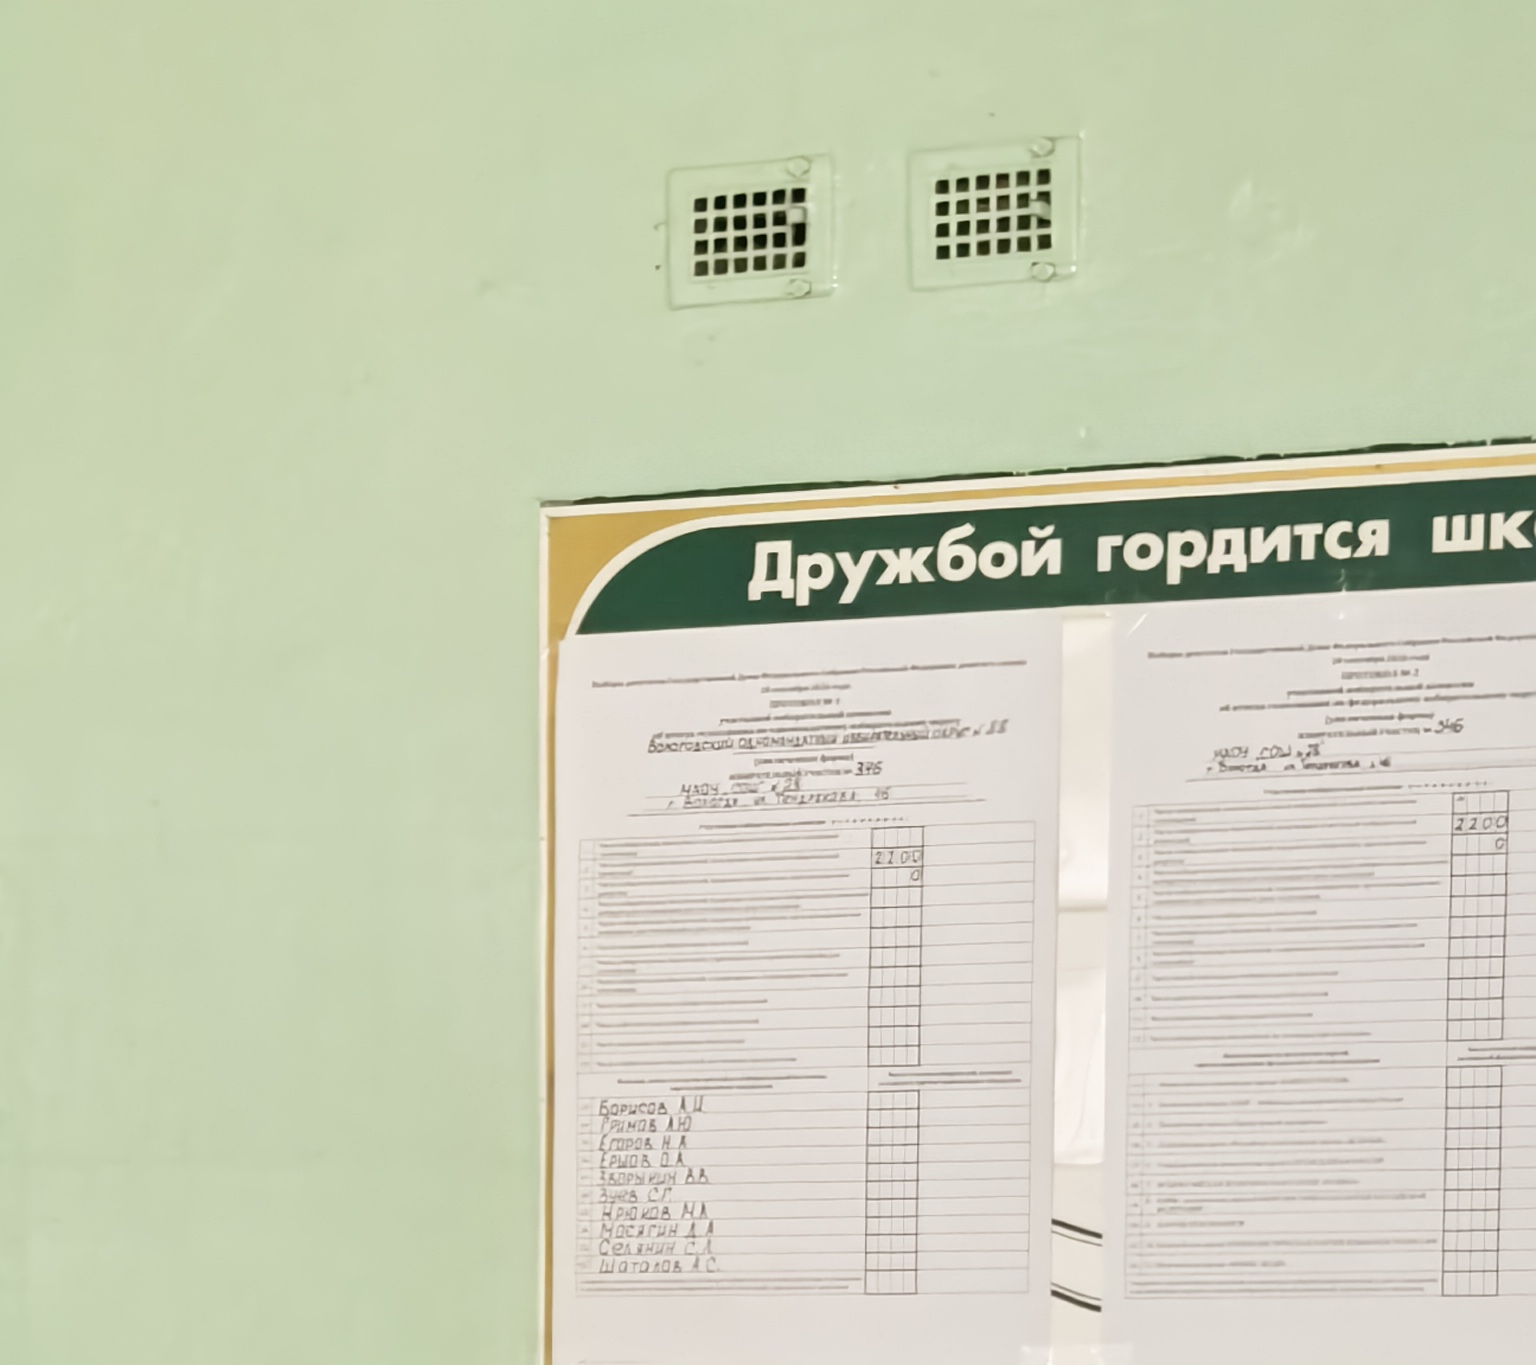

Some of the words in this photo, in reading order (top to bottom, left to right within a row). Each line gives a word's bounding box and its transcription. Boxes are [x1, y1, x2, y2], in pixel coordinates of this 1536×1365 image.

[748, 523, 1062, 606] Дружбой
[1097, 519, 1390, 585] гордится
[1432, 509, 1536, 553] шк
